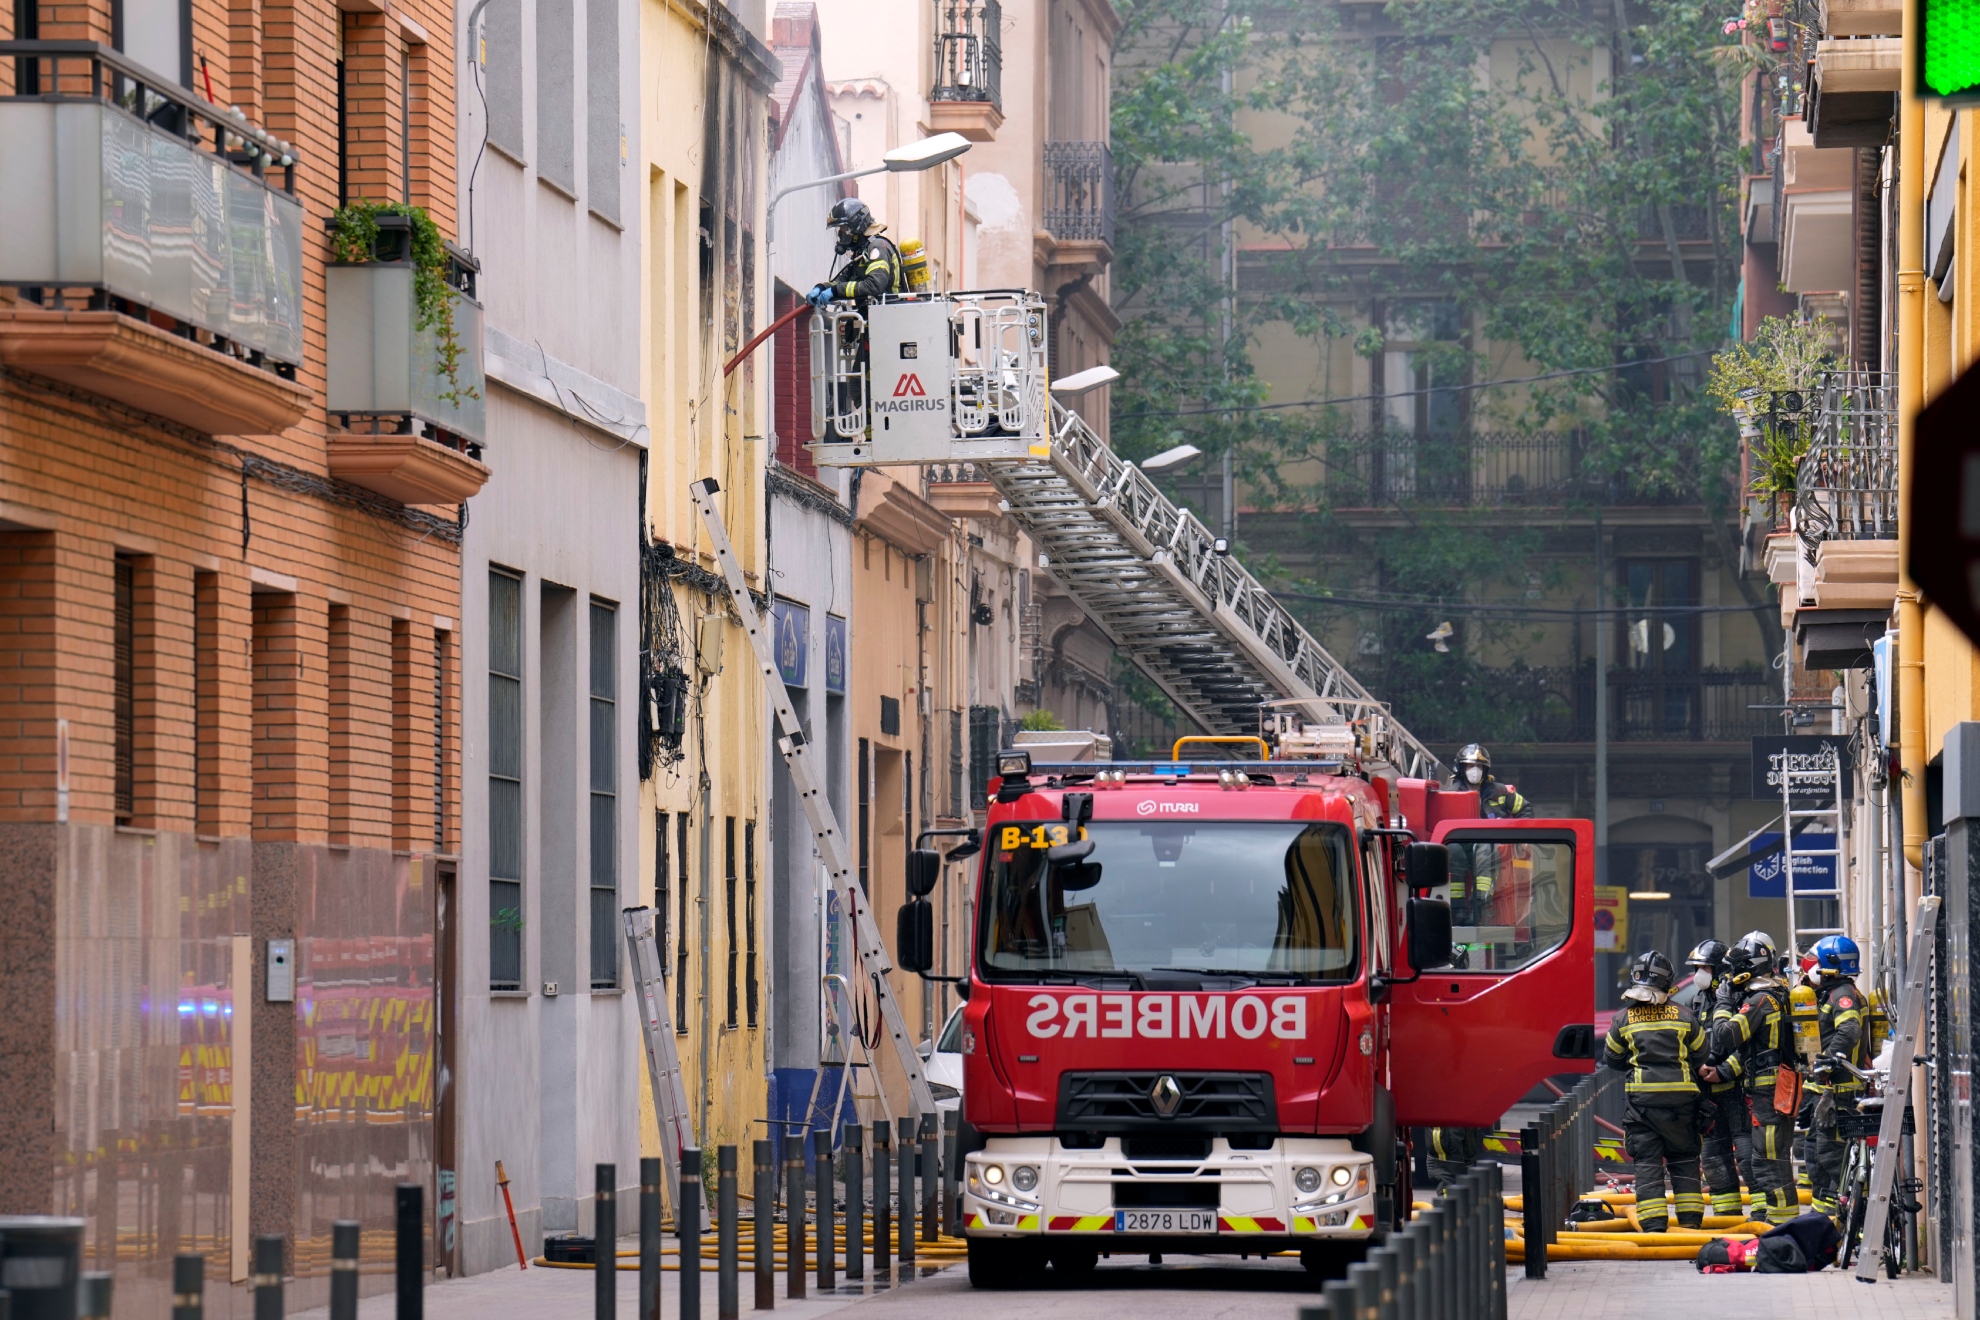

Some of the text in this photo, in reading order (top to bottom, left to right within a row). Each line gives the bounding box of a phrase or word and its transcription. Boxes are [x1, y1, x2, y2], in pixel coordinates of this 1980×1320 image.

[874, 398, 946, 413] MAGIRUS
[1767, 753, 1836, 771] TERRA
[1799, 787, 1831, 795] argentino
[1160, 802, 1199, 813] ITURRI
[1781, 856, 1813, 865] Eglish
[1781, 865, 1829, 874] Cnnection
[1627, 1004, 1679, 1017] BOMBERS
[1628, 1013, 1679, 1024] BARCELONA
[1128, 1213, 1172, 1230] 2878
[1179, 1213, 1212, 1230] LDW
